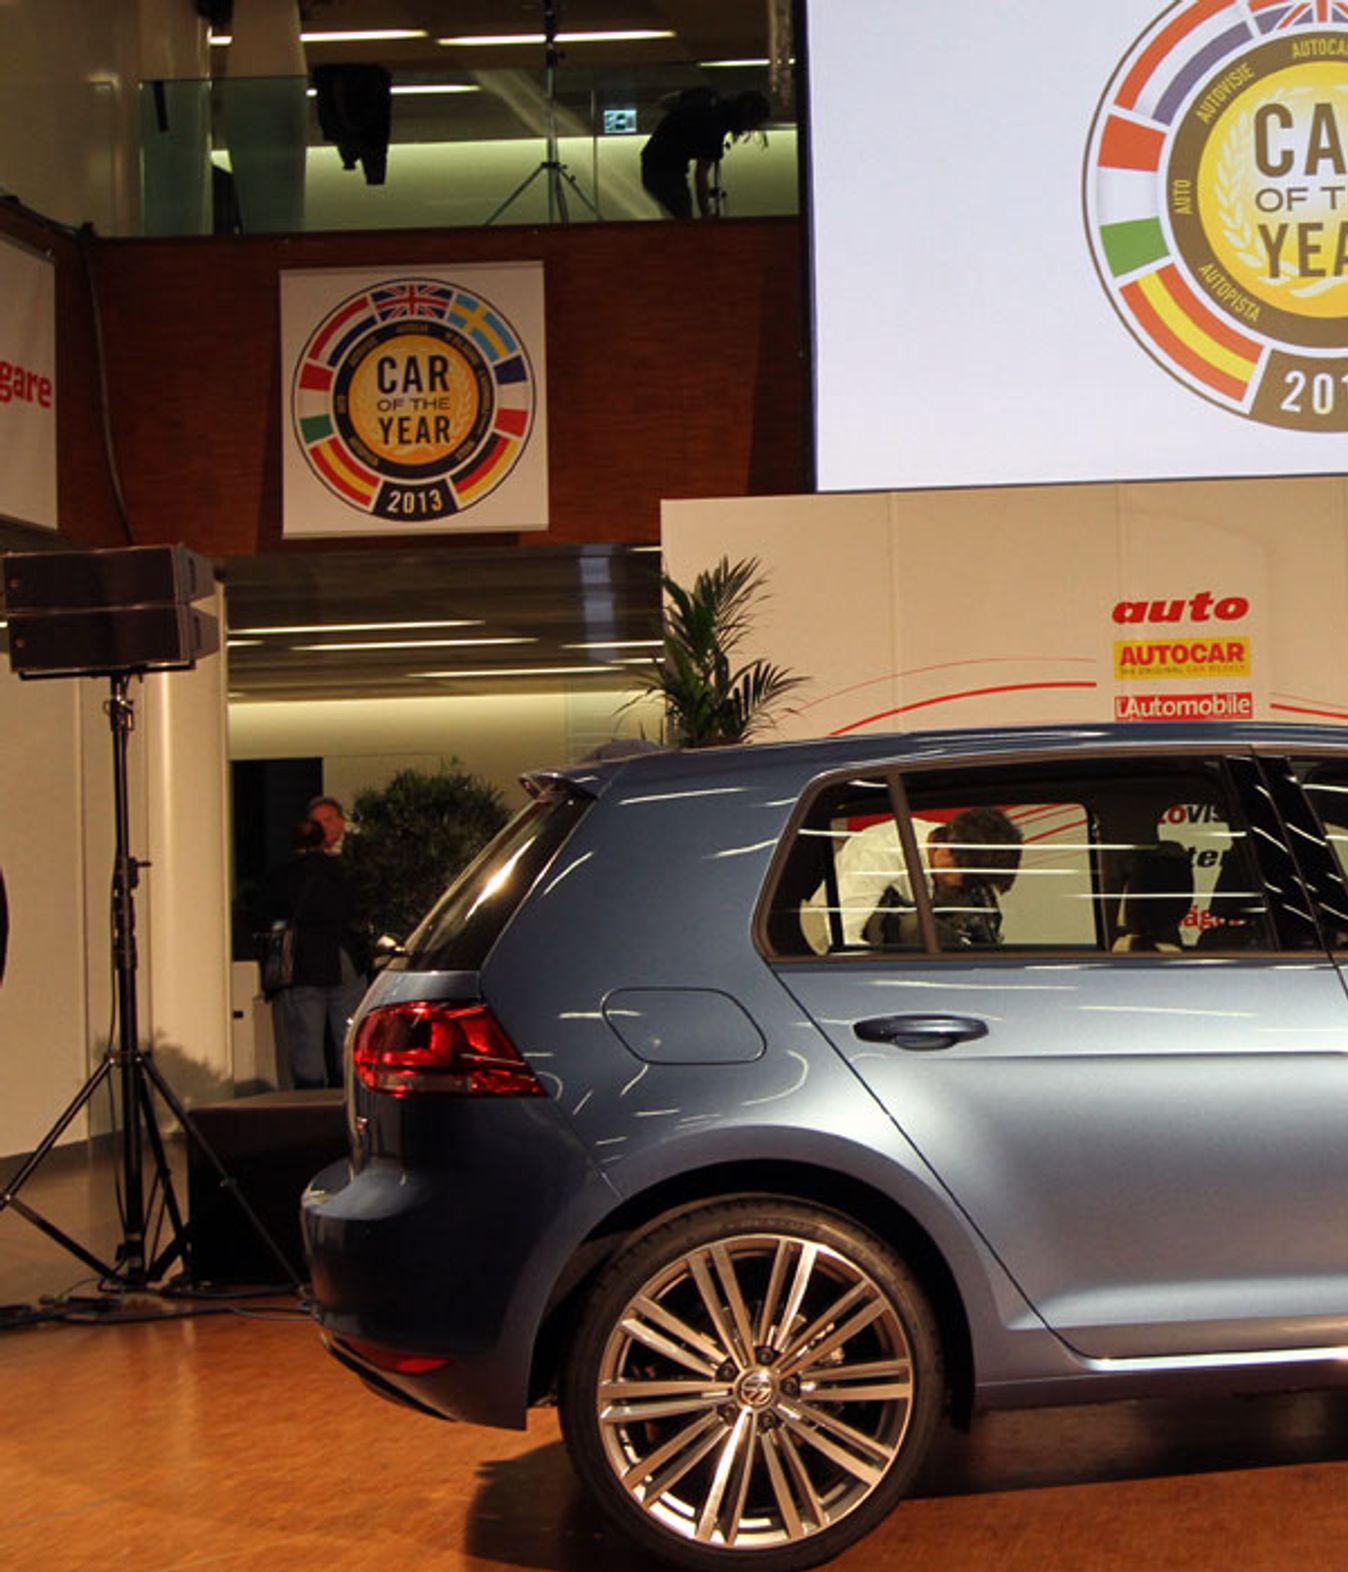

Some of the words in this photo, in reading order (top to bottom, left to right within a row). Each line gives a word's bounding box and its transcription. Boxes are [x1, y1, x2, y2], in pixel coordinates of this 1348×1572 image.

[1196, 63, 1254, 124] AUTOVISIE
[1173, 179, 1192, 215] AUTO
[1255, 186, 1308, 212] OF
[1199, 263, 1261, 322] AUTOPISTA
[377, 355, 449, 394] CAR
[377, 398, 402, 412] OF
[410, 397, 450, 410] THE
[378, 416, 450, 445] YEAR
[387, 489, 443, 513] 2013
[1112, 591, 1249, 624] auto
[1120, 642, 1245, 666] AUTOCAR
